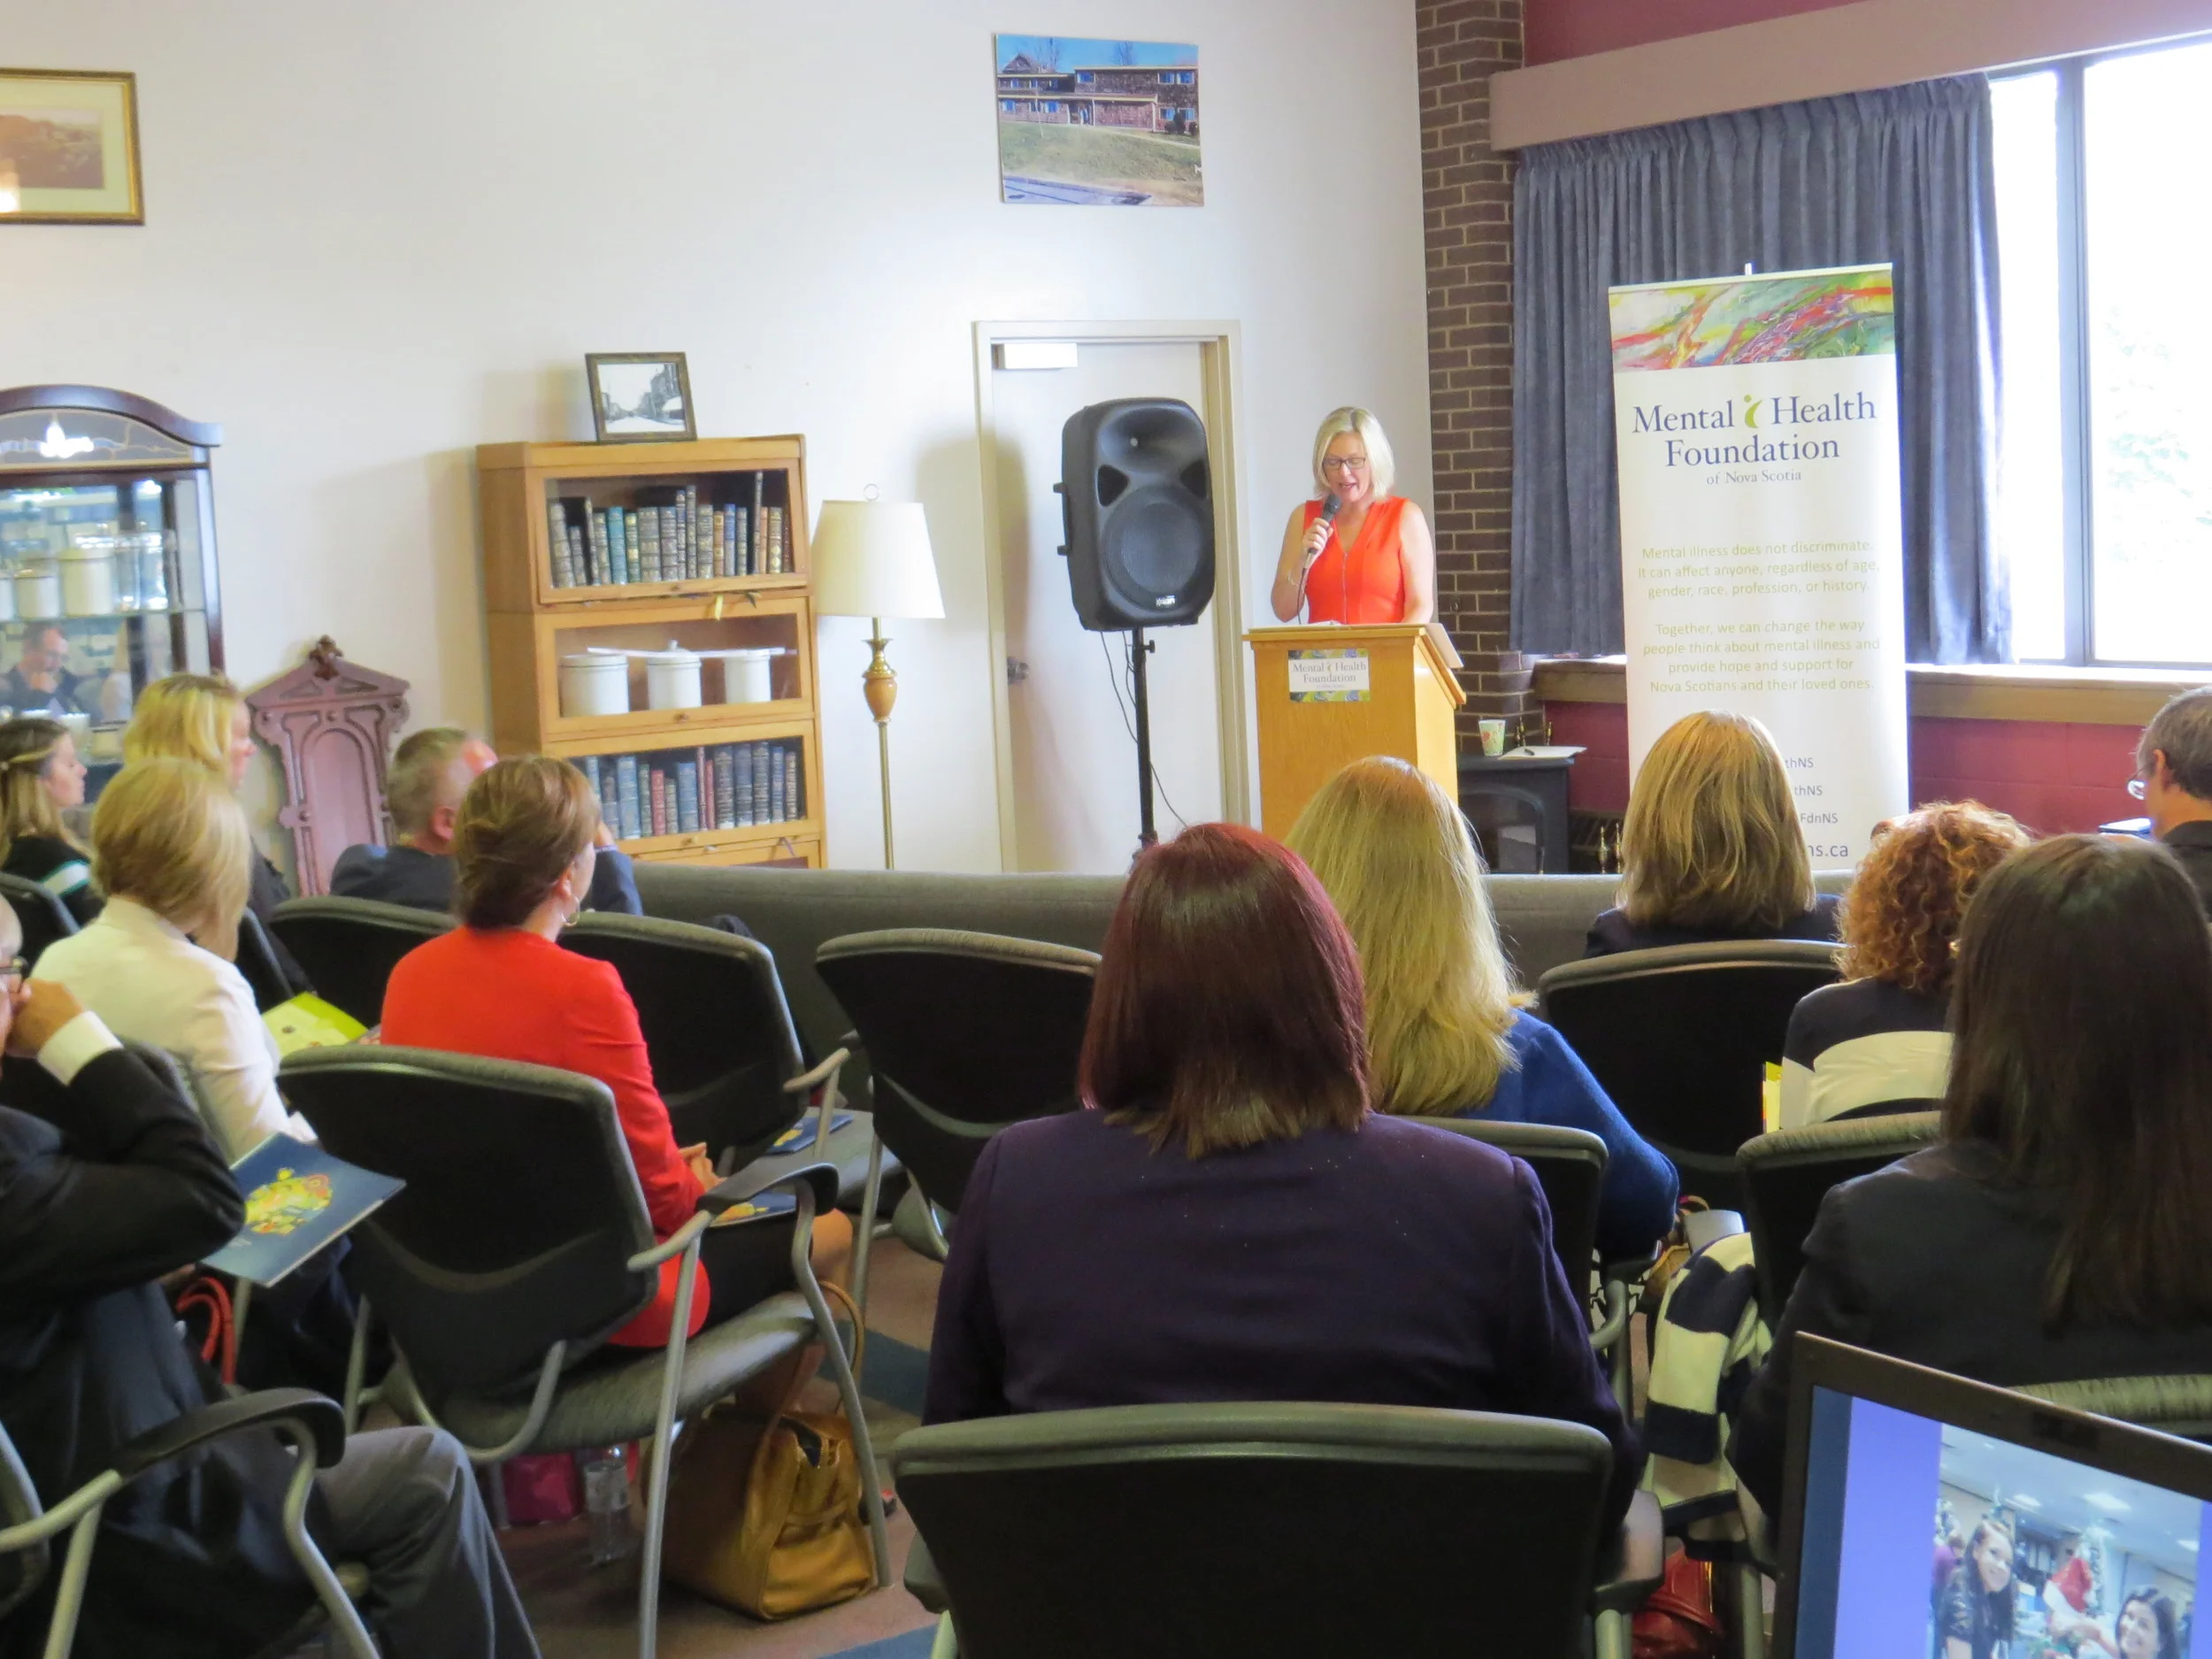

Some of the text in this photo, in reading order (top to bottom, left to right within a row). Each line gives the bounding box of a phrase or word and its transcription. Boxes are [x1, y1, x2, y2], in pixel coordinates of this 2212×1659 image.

[1632, 391, 1878, 434] Mental Health
[1664, 433, 1840, 467] Foundation
[1706, 469, 1801, 486] of Nova Scotia
[1642, 547, 1686, 558] Mental
[1690, 545, 1728, 557] illness
[1732, 544, 1762, 555] does
[1765, 542, 1787, 554] not
[1639, 567, 1647, 579] It
[1650, 568, 1671, 577] can
[1675, 565, 1710, 577] affect
[1714, 564, 1763, 578] anyone,
[1767, 560, 1832, 575] regardless
[1836, 559, 1849, 572] of
[1648, 586, 1694, 599] gender,
[1732, 580, 1801, 596] profession,
[1806, 582, 1819, 592] or
[1823, 580, 1870, 592] history.
[1655, 619, 1864, 637] Together, we can change the way
[1643, 638, 1879, 657] people think about mental illness and
[1293, 662, 1325, 672] Mental
[1669, 658, 1853, 674] provide hope and support for
[1303, 673, 1356, 684] Foundation
[1650, 681, 1681, 693] Nova
[1685, 680, 1737, 692] Scotians
[1740, 680, 1763, 691] and
[1768, 679, 1797, 690] their
[1801, 678, 1836, 690] loved
